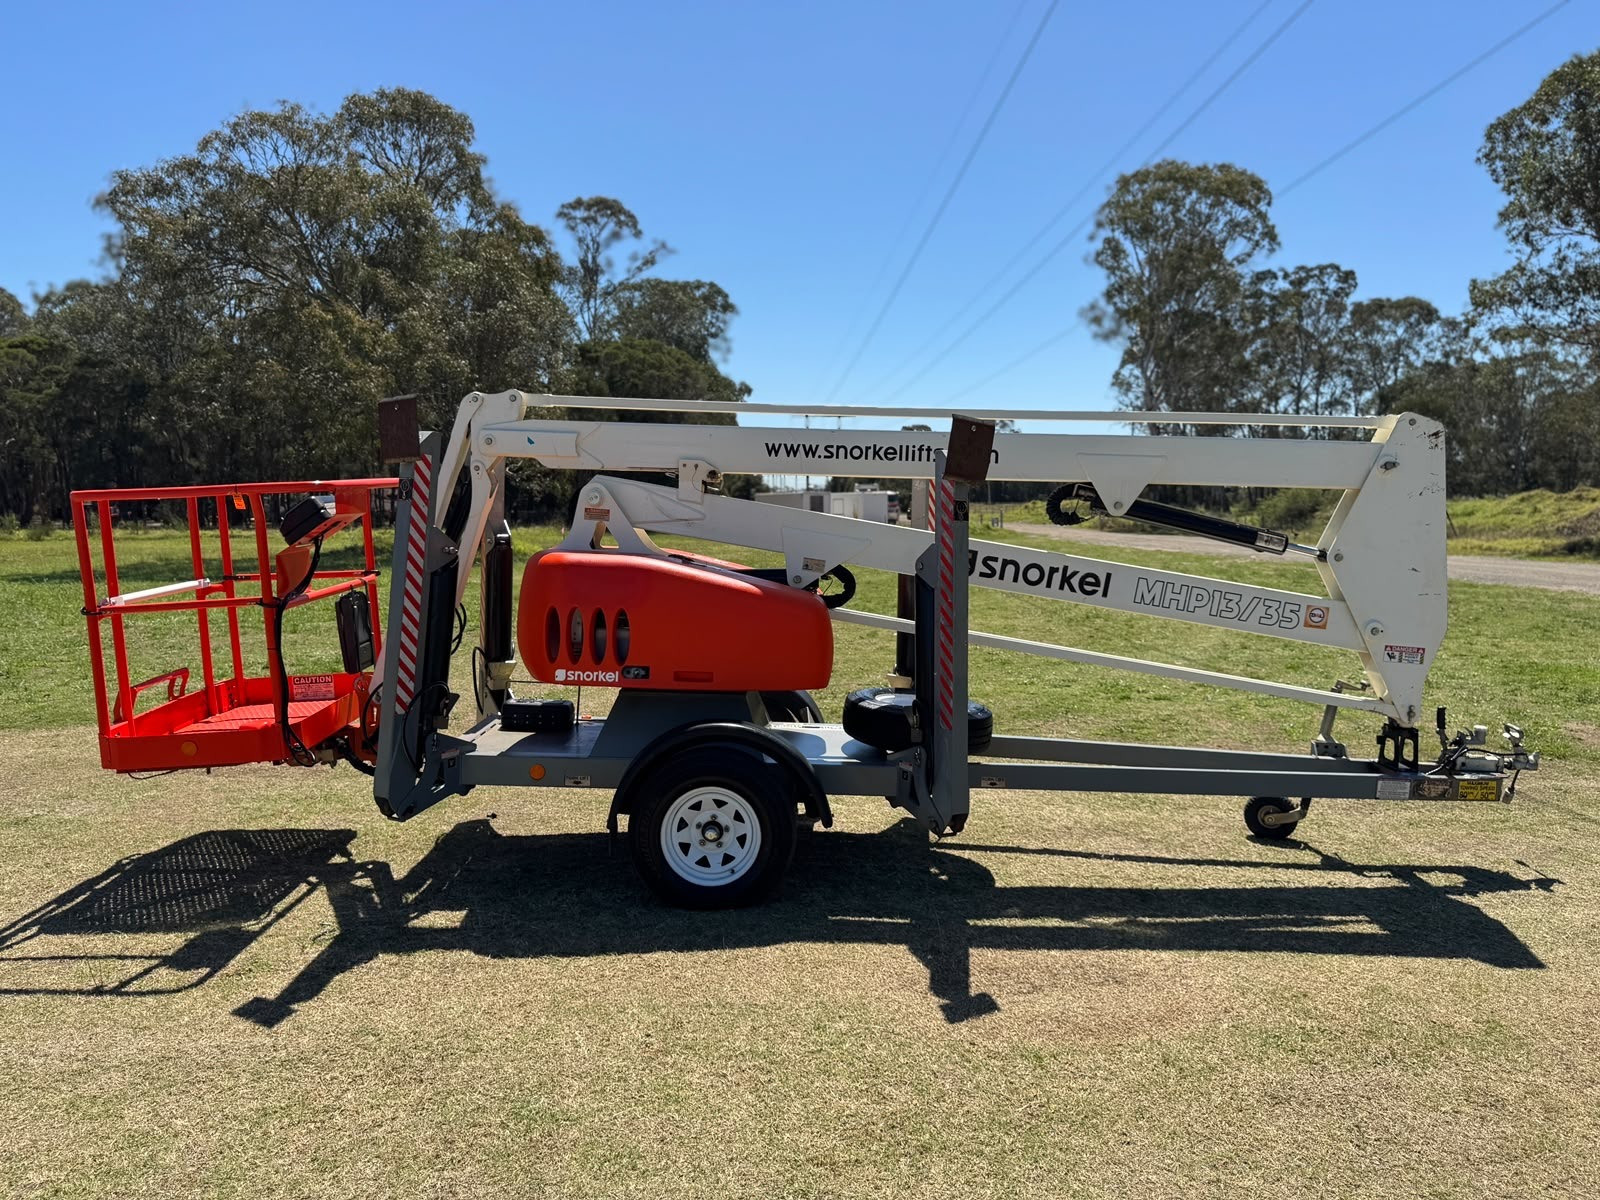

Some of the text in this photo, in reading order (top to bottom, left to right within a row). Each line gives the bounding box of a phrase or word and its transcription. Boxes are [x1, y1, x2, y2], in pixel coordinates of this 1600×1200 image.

[764, 442, 999, 464] www.snorkellift
[979, 555, 1112, 598] snorkel
[1133, 577, 1300, 629] MHP13/35
[1391, 645, 1418, 654] DANGER
[294, 676, 332, 684] CAUTION
[567, 670, 619, 683] snorkel
